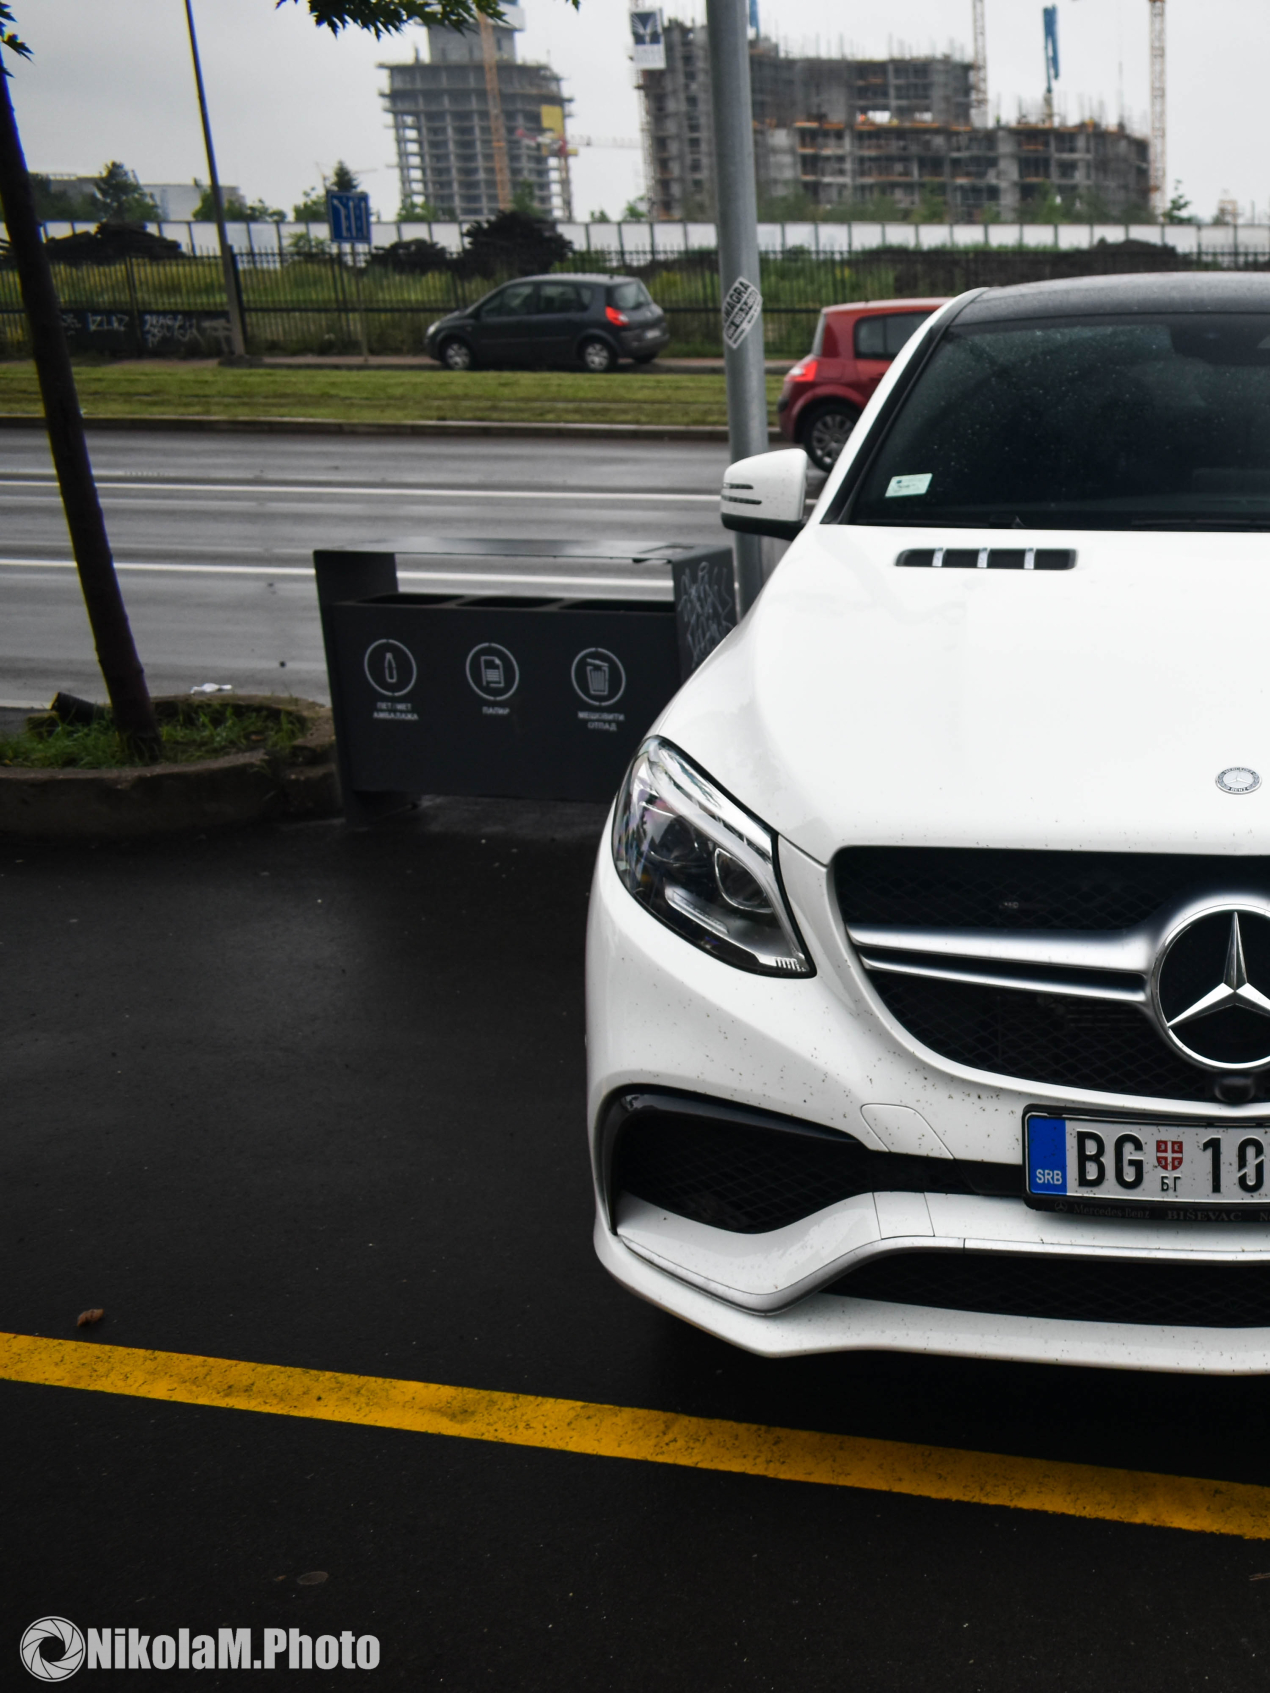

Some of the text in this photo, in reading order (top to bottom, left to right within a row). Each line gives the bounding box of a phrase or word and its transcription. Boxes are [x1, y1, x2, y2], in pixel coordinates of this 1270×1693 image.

[587, 721, 617, 731] ОТПАД
[1076, 1129, 1144, 1190] BG
[1036, 1169, 1063, 1185] SRB
[1160, 1176, 1182, 1193] БГ
[1073, 1204, 1150, 1219] Mercedes-Benz
